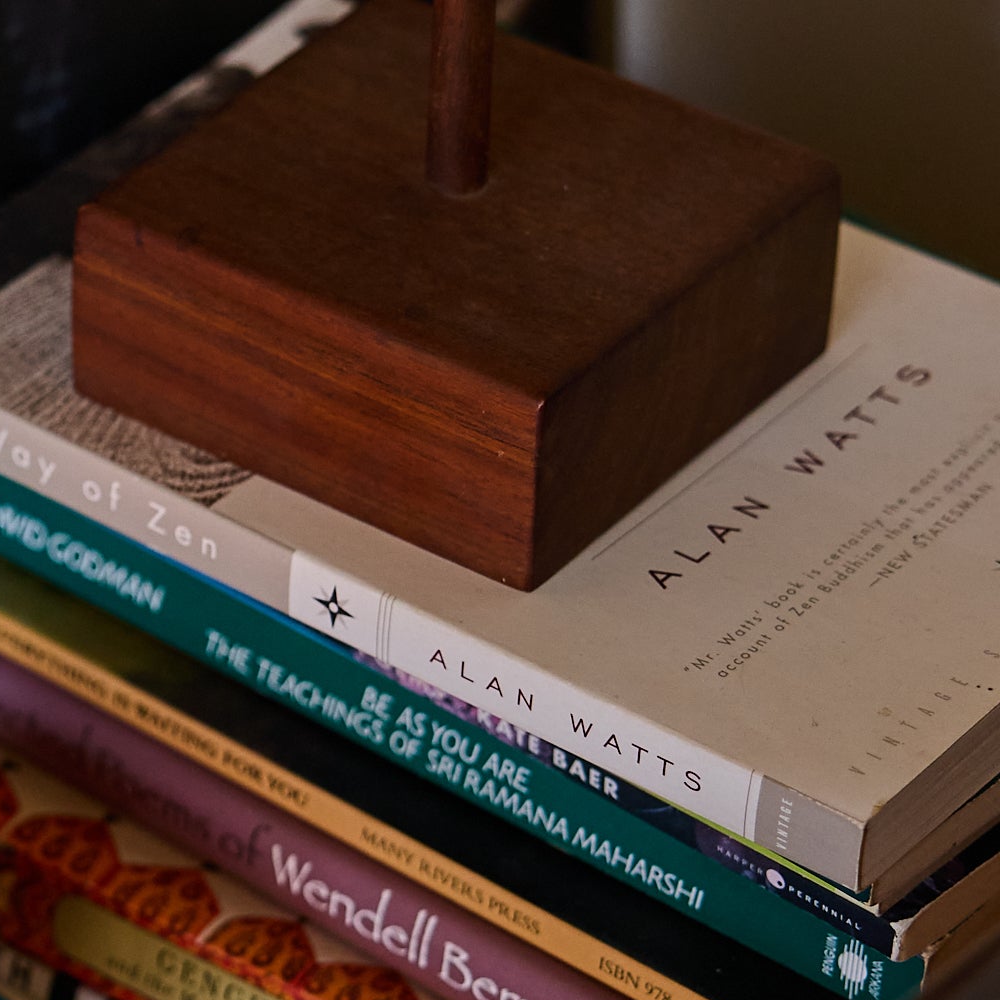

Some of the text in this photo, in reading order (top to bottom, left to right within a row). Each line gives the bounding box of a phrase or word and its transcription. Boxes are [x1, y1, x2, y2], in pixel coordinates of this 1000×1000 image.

[82, 480, 124, 511] of
[147, 502, 218, 560] Zen
[646, 496, 771, 590] ALAN
[783, 363, 933, 476] WATTS
[911, 482, 994, 549] STATESMAN
[763, 580, 805, 609] book
[802, 567, 822, 581] is
[823, 517, 885, 567] certainly
[717, 633, 772, 679] account
[774, 617, 791, 633] of
[788, 595, 820, 618] Zen
[817, 541, 886, 594] Buddhism
[360, 684, 533, 795] BE AS YOU ARE
[429, 648, 702, 792] ALAN WATTS
[476, 707, 620, 800] KATE BAER
[848, 676, 970, 776] VINTAGE
[205, 627, 706, 911] THE TEACHINGS OF SRI RAMANA MAHARSHI
[775, 797, 794, 851] VINTAGE
[269, 843, 439, 968] Wendell
[488, 897, 541, 936] PRESS
[716, 845, 863, 931] HARPER PERENNIAL
[598, 956, 641, 991] ISBN
[821, 933, 839, 977] PENGUIN
[868, 960, 885, 1000] ARKANA
